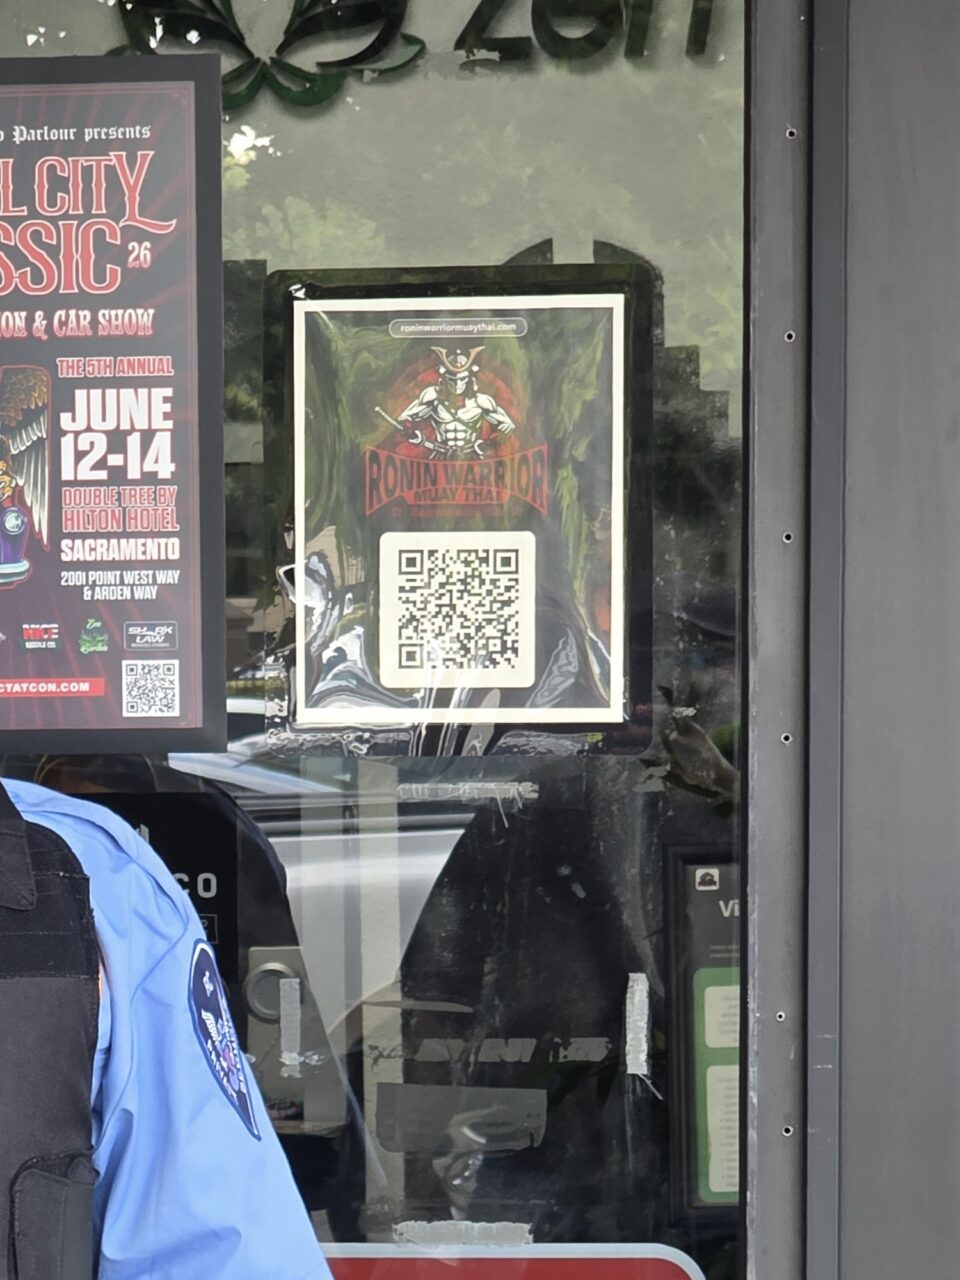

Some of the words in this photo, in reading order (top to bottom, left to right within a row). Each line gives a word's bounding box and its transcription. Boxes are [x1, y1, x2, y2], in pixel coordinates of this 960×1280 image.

[12, 125, 77, 144] Parlour
[84, 124, 151, 142] presents
[35, 151, 177, 234] CITY
[128, 242, 151, 268] 26
[33, 310, 48, 340] &
[54, 309, 92, 337] CAR
[98, 308, 155, 335] SHOW
[57, 357, 83, 377] THE
[85, 357, 114, 376] 5TH
[116, 356, 174, 376] ANNUAL
[59, 387, 174, 431] JUNE
[60, 431, 176, 481] 12-14
[368, 450, 438, 512] RONIN
[442, 449, 546, 512] WARRIOR
[62, 487, 119, 507] DOUBLE
[120, 486, 153, 506] TREE
[155, 486, 178, 505] BY
[413, 490, 459, 501] MUAY
[463, 490, 501, 501] THAI
[62, 508, 122, 532] HILTON
[127, 507, 180, 531] HOTEL
[60, 537, 180, 562] SACRAMENTO
[60, 571, 86, 585] 2001
[88, 571, 122, 585] POINT
[123, 570, 153, 585] WEST
[154, 570, 180, 585] WAY
[83, 586, 92, 600] &
[94, 586, 131, 600] ARDEN
[132, 585, 158, 600] WAY
